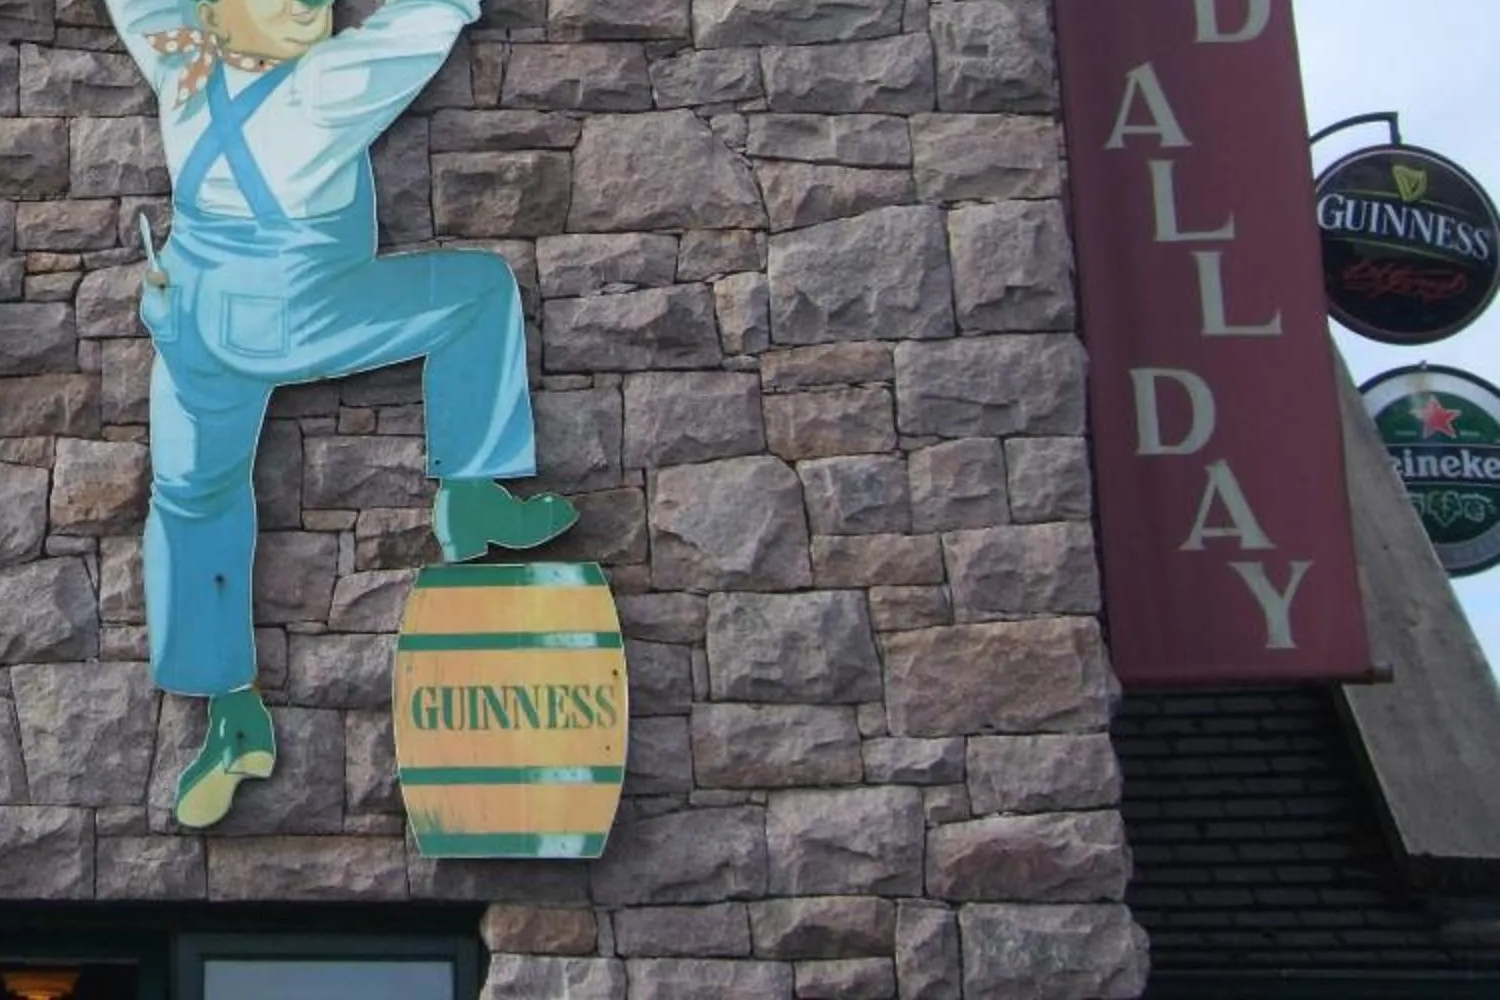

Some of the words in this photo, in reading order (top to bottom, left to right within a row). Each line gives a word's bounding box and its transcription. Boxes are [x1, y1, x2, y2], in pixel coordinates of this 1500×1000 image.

[1103, 62, 1283, 336] ALL
[1316, 193, 1489, 260] GUINNESS
[1129, 367, 1313, 650] DAY
[411, 683, 619, 732] GUINNESS
